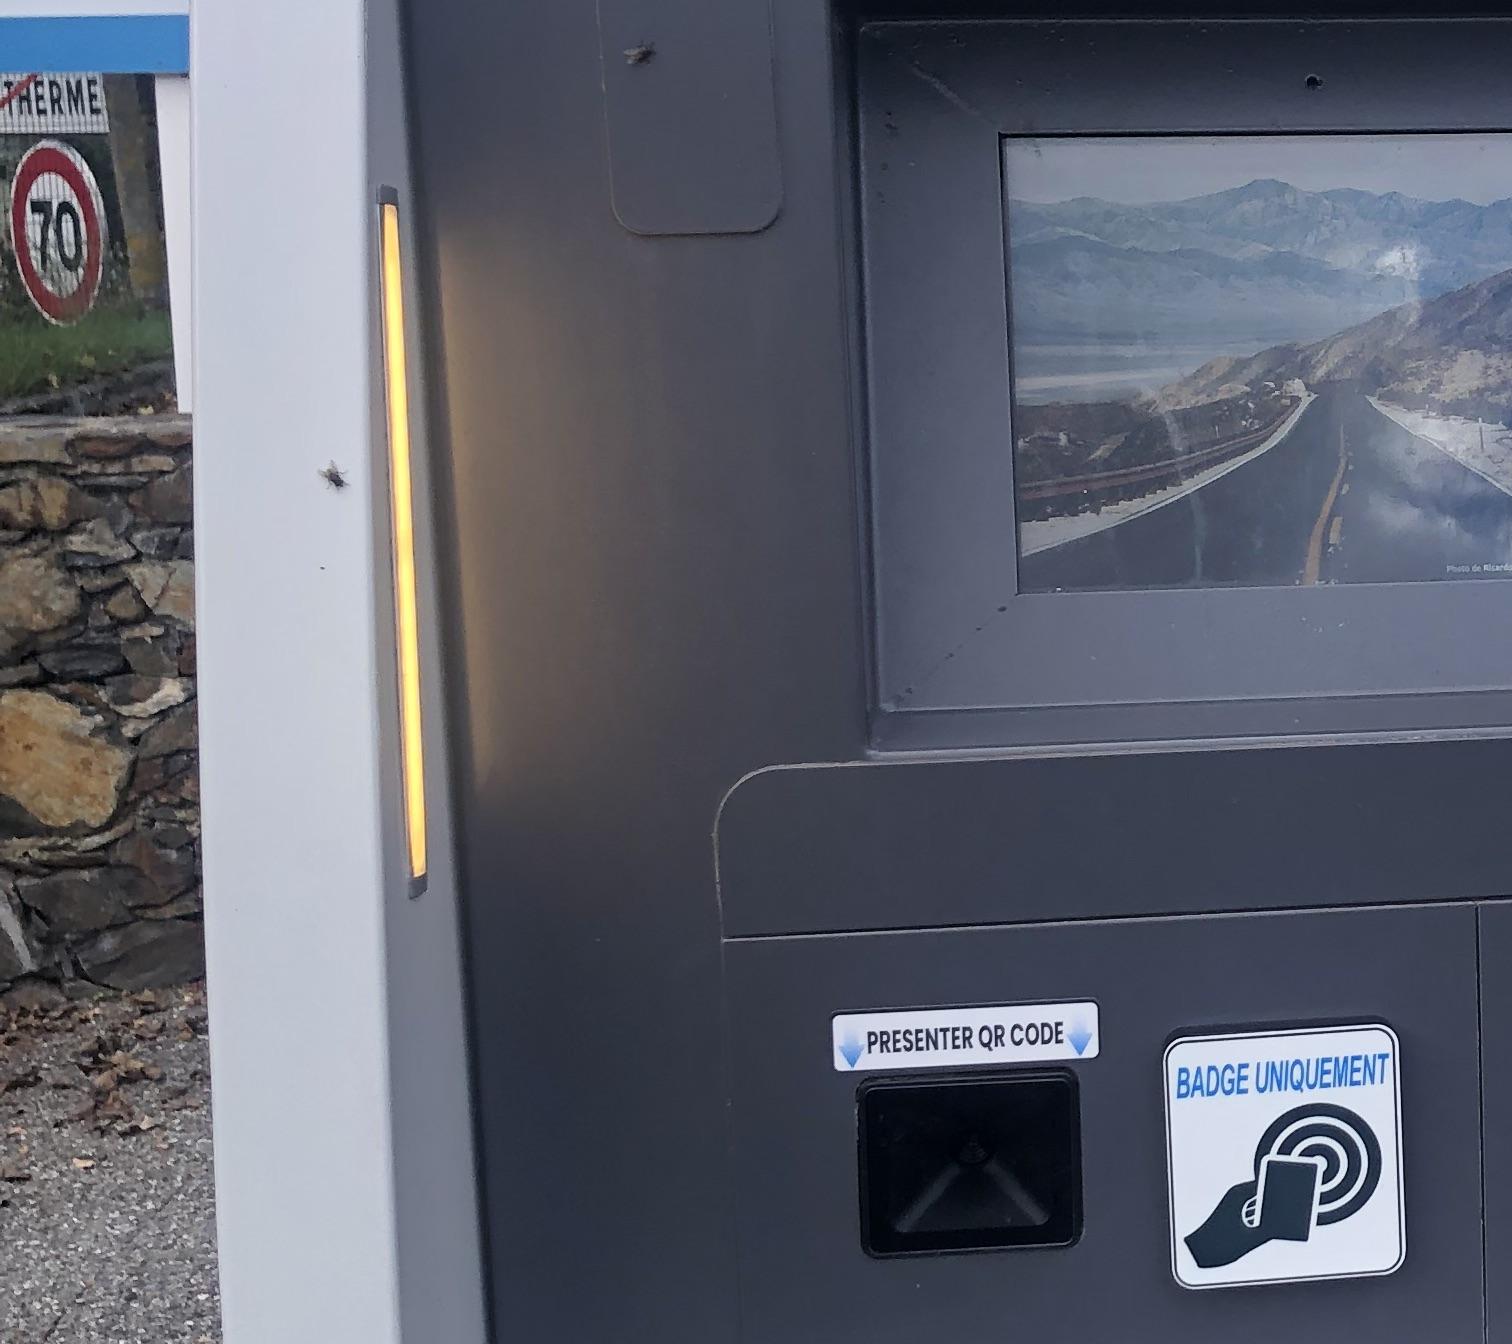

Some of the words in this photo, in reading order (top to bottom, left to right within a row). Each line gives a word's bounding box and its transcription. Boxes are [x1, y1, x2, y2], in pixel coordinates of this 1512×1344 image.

[4, 78, 102, 115] THERME
[30, 201, 83, 273] 70
[1483, 563, 1512, 572] Ricardo
[866, 1025, 974, 1055] PRESENTER
[978, 1024, 1006, 1051] QR
[1010, 1022, 1064, 1047] CODE
[1176, 1062, 1250, 1100] BADGE
[1255, 1053, 1390, 1095] UNIQUEMENT
